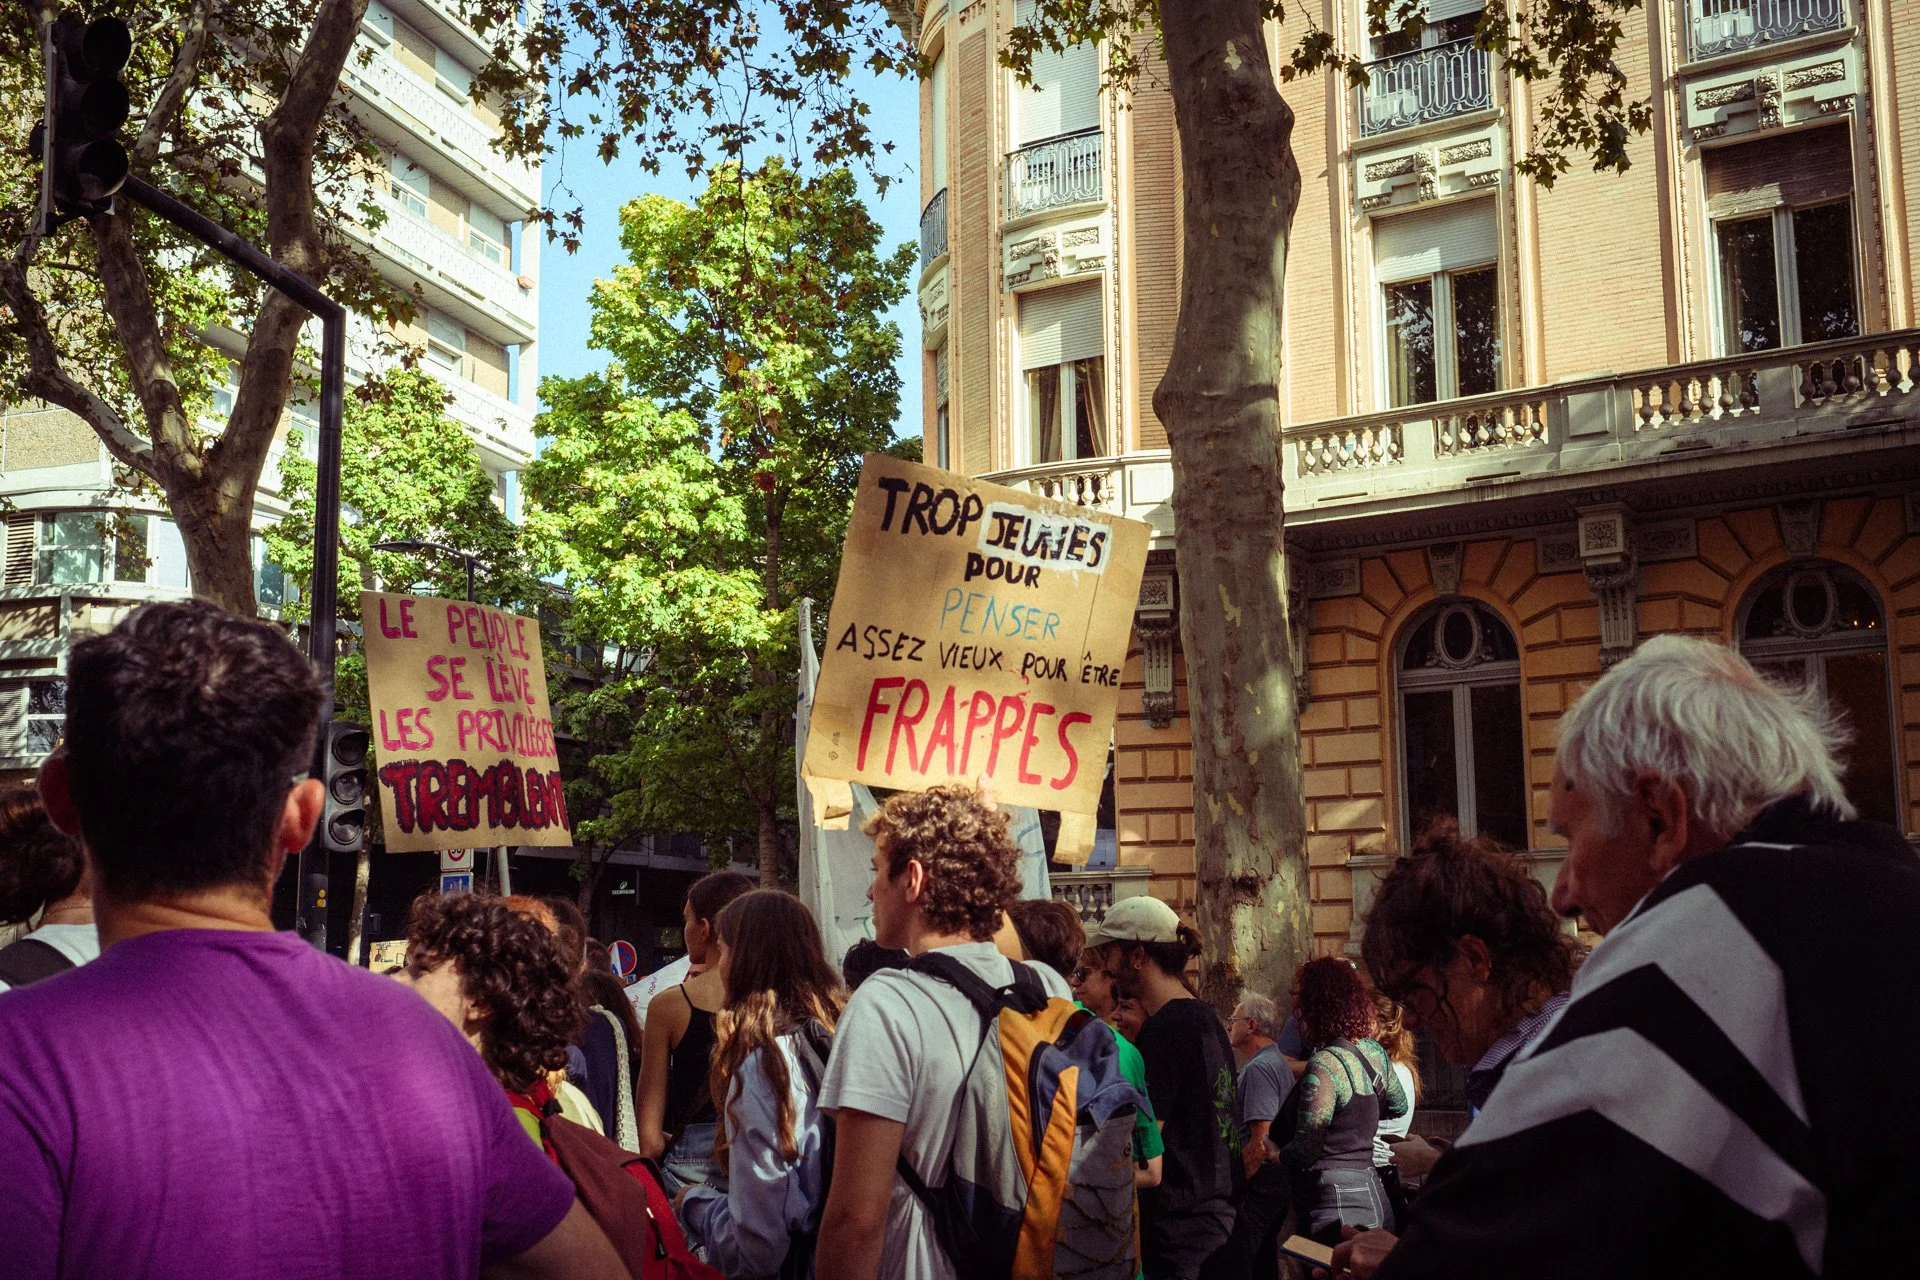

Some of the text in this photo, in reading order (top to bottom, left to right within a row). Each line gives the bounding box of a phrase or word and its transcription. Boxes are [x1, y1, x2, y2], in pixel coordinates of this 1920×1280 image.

[878, 477, 984, 537] TROP
[964, 551, 1042, 589] POUR
[380, 598, 530, 661] LE PEUPLE
[940, 588, 1061, 642] PENSER
[425, 653, 536, 705] SE LÈVE
[836, 623, 1121, 688] ASSEZ VIEUX POUR ÊTRE
[380, 708, 435, 751] LES
[378, 758, 570, 834] TREMBLENT
